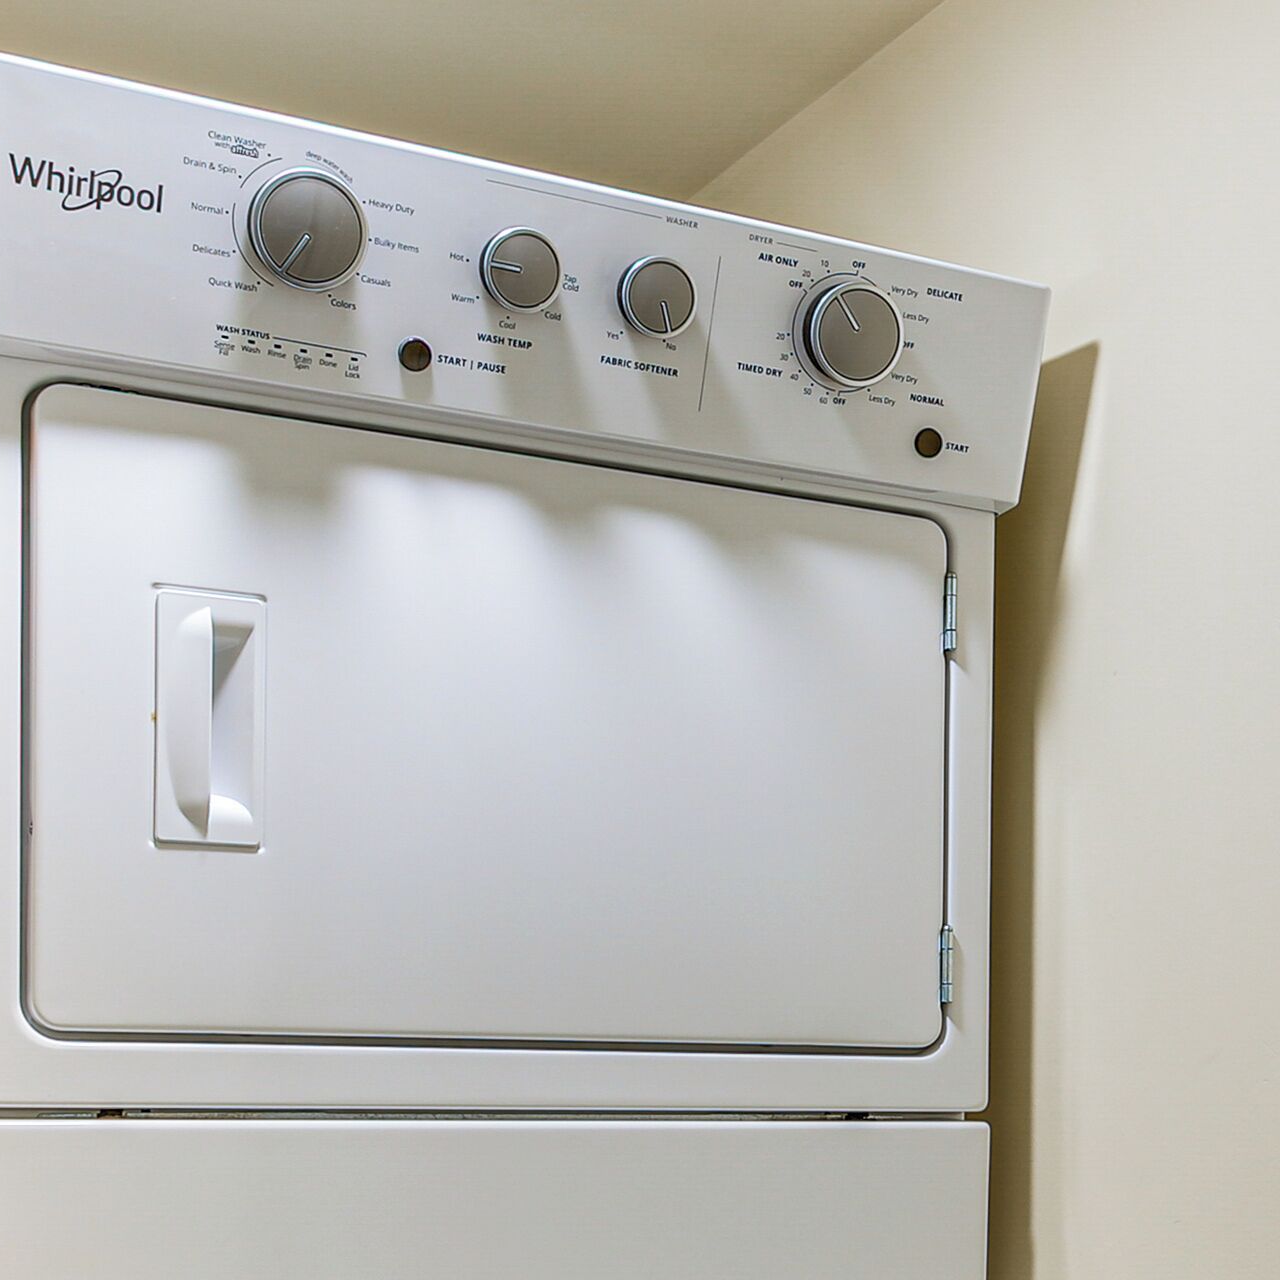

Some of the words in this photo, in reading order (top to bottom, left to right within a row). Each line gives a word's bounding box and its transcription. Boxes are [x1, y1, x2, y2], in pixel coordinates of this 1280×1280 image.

[207, 130, 232, 143] Clean
[234, 134, 266, 149] Washer
[183, 156, 207, 168] Drain
[208, 161, 216, 170] &
[217, 163, 237, 175] Spin
[9, 152, 164, 214] Whirlpool
[190, 202, 224, 215] Normal
[368, 198, 393, 213] Heavy
[394, 204, 416, 216] Duty
[666, 216, 699, 229] WASHER
[374, 237, 395, 250] Bulky
[396, 242, 420, 254] Items
[749, 234, 774, 246] DRYER
[192, 244, 231, 258] Delicates
[450, 252, 465, 263] Hot
[758, 252, 774, 263] AIR
[775, 256, 799, 268] ONLY
[852, 261, 866, 269] OFF
[208, 277, 233, 289] Quick
[234, 280, 258, 293] Wash
[361, 275, 392, 288] Casuals
[564, 274, 577, 286] Tap
[789, 280, 803, 289] OFF
[562, 282, 580, 293] Cold
[891, 286, 907, 296] Very
[906, 289, 919, 298] Dry
[451, 293, 476, 305] Warm
[926, 287, 963, 302] DELICATE
[330, 299, 356, 311] Colors
[544, 310, 562, 322] Cold
[902, 312, 917, 321] Less
[917, 314, 930, 324] Dry
[499, 320, 517, 331] Cool
[216, 324, 240, 336] WASH
[241, 329, 270, 340] STATUS
[607, 331, 620, 342] Yes
[776, 332, 786, 341] 20
[477, 332, 506, 347] WASH
[507, 337, 533, 351] TEMP
[666, 342, 677, 352] No
[241, 344, 262, 355] Wash
[268, 350, 287, 360] Rinse
[780, 353, 789, 362] 30
[320, 359, 338, 369] Done
[348, 363, 360, 373] Lid
[437, 354, 468, 369] START
[477, 362, 507, 375] PAUSE
[600, 356, 633, 369] FABRIC
[634, 361, 679, 378] SOFTENER
[737, 362, 764, 375] TIMED
[765, 367, 783, 378] DRY
[345, 371, 361, 381] Lock
[790, 373, 800, 381] 40
[891, 372, 906, 383] Very
[905, 375, 918, 385] Dry
[803, 388, 812, 396] 50
[819, 397, 828, 405] 60
[832, 397, 846, 406] OFF
[869, 394, 884, 404] Less
[884, 397, 896, 407] Dry
[910, 393, 945, 407] NORMAL
[945, 442, 970, 453] START
